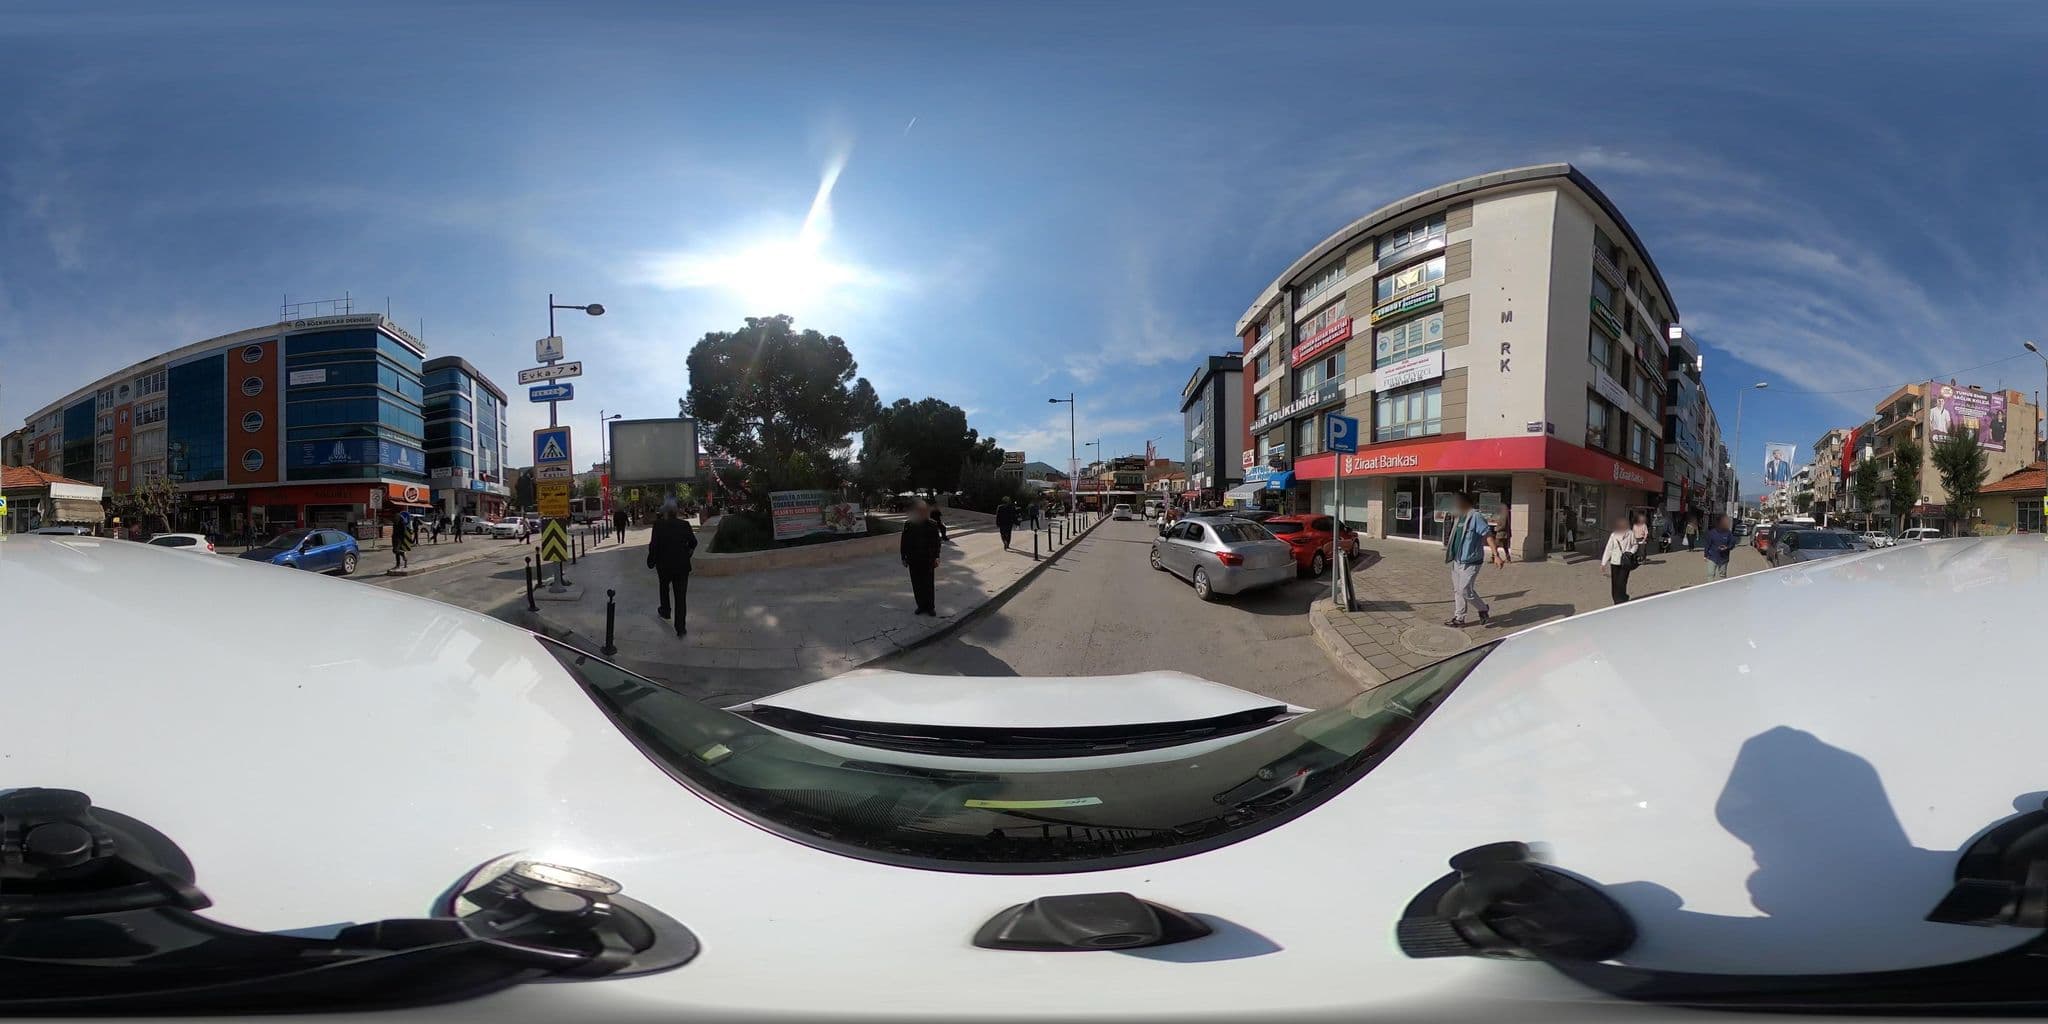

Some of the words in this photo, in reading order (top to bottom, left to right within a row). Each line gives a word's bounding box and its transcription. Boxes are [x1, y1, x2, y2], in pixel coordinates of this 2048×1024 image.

[521, 366, 564, 381] Evka-7
[1354, 456, 1378, 470] Ziraat
[1380, 453, 1418, 469] Bankası
